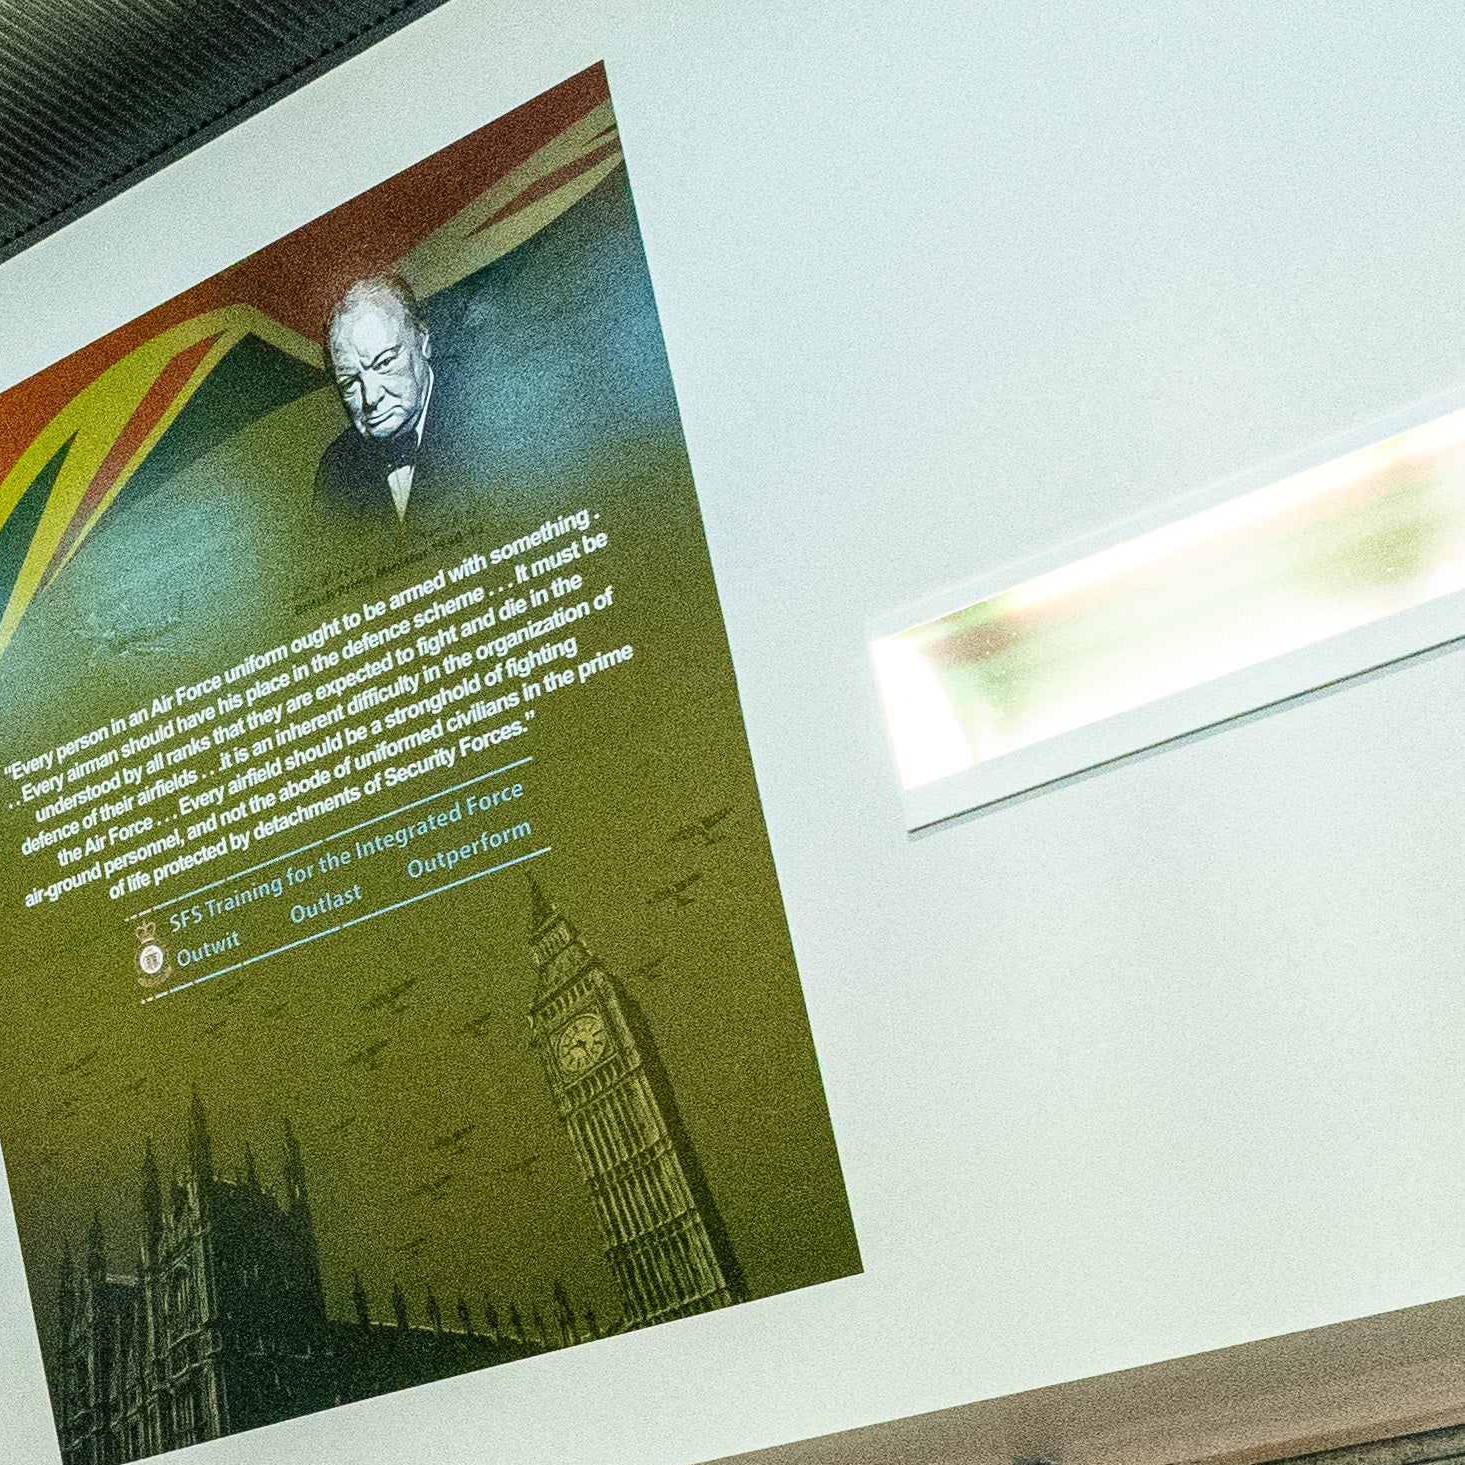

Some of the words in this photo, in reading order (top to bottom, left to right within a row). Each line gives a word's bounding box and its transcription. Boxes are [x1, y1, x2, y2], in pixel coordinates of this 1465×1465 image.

[21, 773, 64, 802] Every
[66, 749, 119, 782] airman
[120, 719, 175, 758] should
[175, 705, 216, 733] have
[216, 692, 244, 715] his
[245, 672, 290, 707] place
[291, 664, 310, 682] in
[310, 651, 339, 673] the
[341, 619, 411, 660] defence
[413, 586, 485, 629] scheme
[514, 563, 530, 584] It
[530, 540, 581, 577] must
[581, 532, 608, 554] be
[21, 820, 80, 856] defence
[81, 807, 98, 829] of
[99, 795, 134, 822] their
[137, 768, 198, 806] airfields
[233, 746, 250, 764] is
[251, 736, 274, 757] an
[274, 703, 345, 746] inherent
[346, 673, 420, 715] difficulty
[422, 665, 441, 683] in
[442, 651, 473, 674] the
[475, 601, 590, 660] organization
[592, 585, 613, 610] of
[35, 771, 121, 823] understood
[122, 765, 143, 785] by
[145, 752, 164, 775] all
[165, 735, 211, 765] ranks
[212, 718, 246, 745] that
[245, 703, 282, 730] they
[285, 691, 313, 714] are
[315, 651, 394, 700] expected
[394, 647, 415, 665] to
[415, 625, 459, 656] fight
[460, 607, 496, 638] and
[498, 597, 527, 621] die
[529, 588, 549, 607] in
[550, 574, 583, 598] the
[55, 726, 109, 764] person
[110, 718, 127, 735] in
[128, 707, 149, 727] an
[151, 695, 174, 718] Air
[174, 675, 222, 706] Force
[223, 645, 288, 684] uniform
[290, 618, 342, 653] ought
[341, 612, 361, 631] to
[362, 601, 386, 621] be
[389, 569, 446, 610] armed
[447, 553, 487, 583] with
[489, 508, 590, 564] something
[57, 846, 82, 867] the
[84, 834, 107, 856] Air
[107, 816, 153, 846] Force
[178, 785, 225, 815] Every
[227, 756, 283, 795] airfield
[284, 731, 343, 771] should
[343, 725, 368, 746] be
[370, 719, 383, 735] a
[384, 672, 482, 729] stronghold
[483, 662, 503, 687] of
[504, 637, 578, 678] fighting
[25, 861, 102, 907] air-ground
[103, 828, 185, 879] personnel,
[186, 812, 218, 840] and
[219, 801, 248, 826] not
[248, 792, 276, 814] the
[278, 769, 331, 802] abode
[333, 755, 351, 779] of
[353, 718, 444, 771] uniformed
[445, 691, 520, 732] civilians
[521, 682, 541, 702] in
[542, 669, 575, 692] the
[577, 644, 633, 684] prime
[108, 878, 125, 899] of
[126, 870, 151, 892] life
[152, 836, 228, 886] protected
[228, 830, 250, 851] by
[252, 786, 362, 840] detachments
[363, 772, 382, 795] of
[383, 746, 456, 787] Security
[169, 905, 203, 932] SFS
[204, 878, 283, 917] Training
[286, 865, 313, 886] for
[318, 850, 351, 873] the
[355, 801, 462, 859] Integrated
[465, 783, 523, 815] Force
[176, 931, 240, 967] Outwit
[290, 884, 362, 923] Outlast
[407, 821, 532, 878] Outperform
